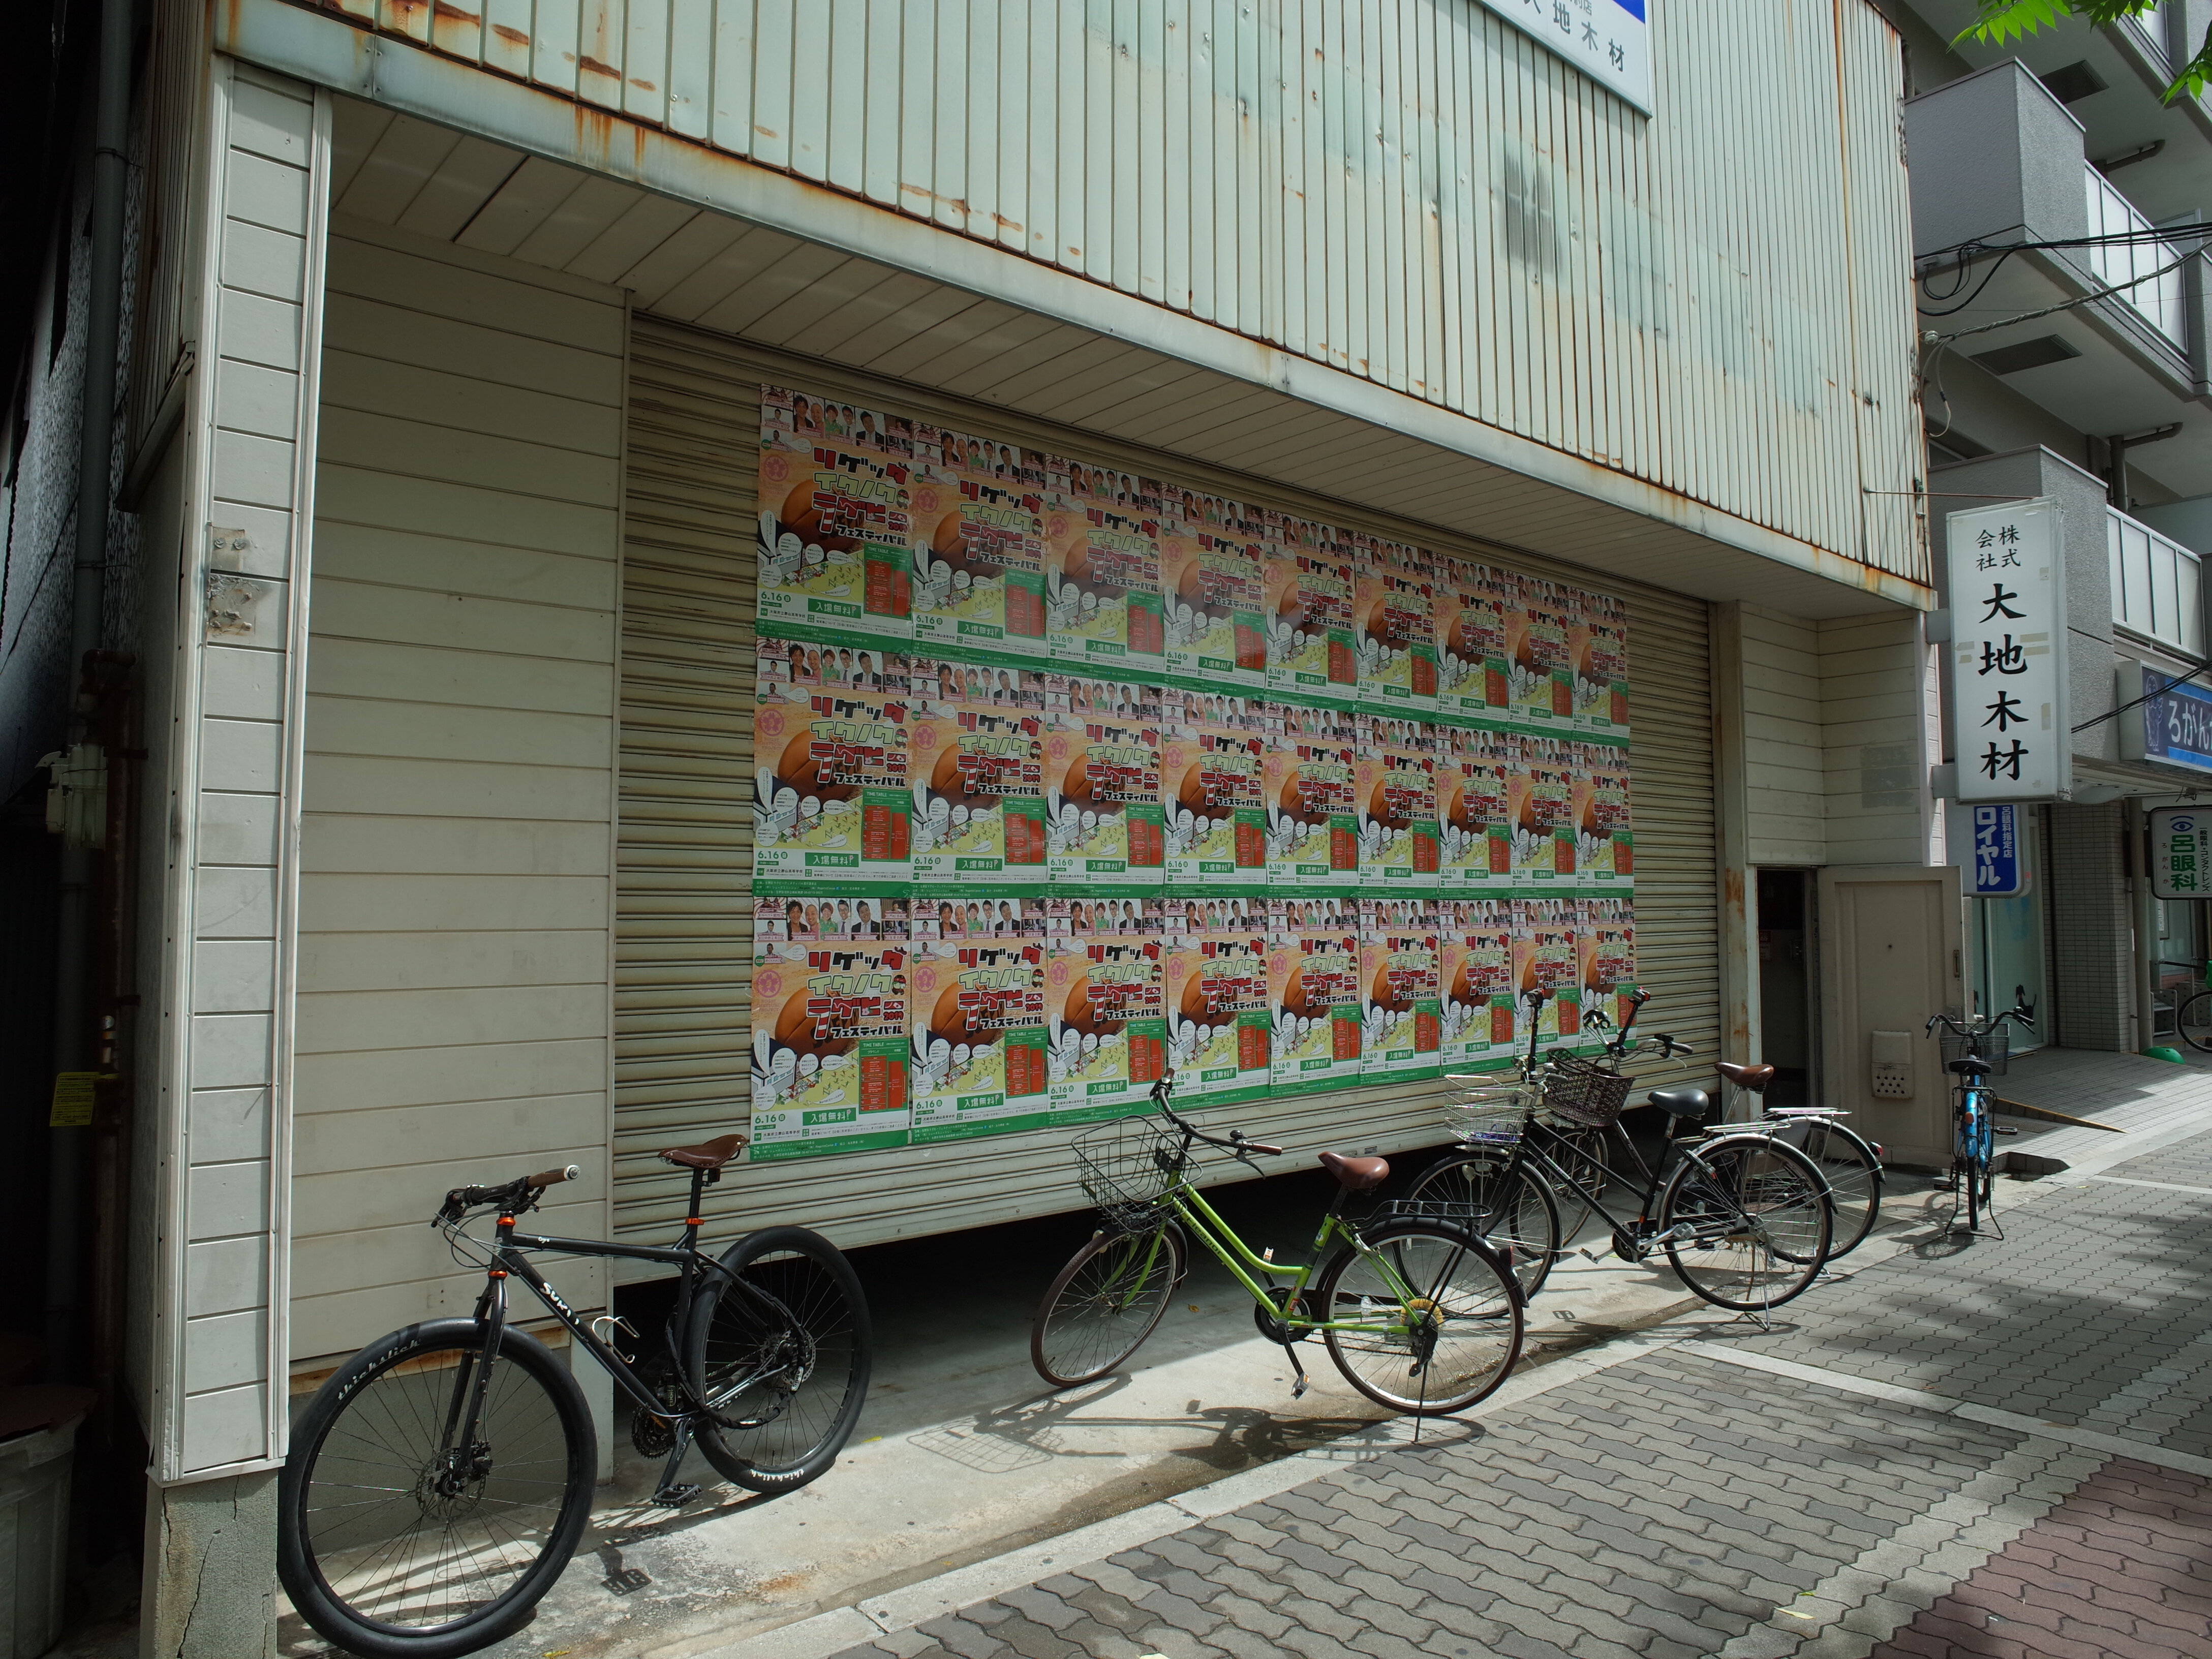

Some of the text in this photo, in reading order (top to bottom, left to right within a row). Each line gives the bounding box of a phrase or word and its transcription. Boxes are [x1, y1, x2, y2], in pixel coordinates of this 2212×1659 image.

[813, 493, 908, 532] ラグビー
[887, 521, 907, 533] 2019
[837, 525, 907, 546] フェスティバル
[960, 523, 1041, 559] ラグビー
[1024, 548, 1041, 559] 2019
[981, 552, 1041, 571] フェスティバル
[1087, 547, 1158, 581] ラグビー
[1144, 570, 1158, 580] 2019
[1105, 575, 1159, 592] フェスティバル
[1199, 570, 1261, 602] ラグビー
[761, 591, 782, 602] 6.16
[1248, 592, 1262, 601] 2019
[1215, 596, 1262, 612] フェスティバル
[917, 615, 935, 625] 6.16
[1311, 615, 1353, 629] フェスティバル
[1050, 634, 1066, 643] 6.16
[1396, 631, 1433, 644] フェスティバル
[1167, 651, 1181, 660] 6.16
[1978, 583, 2028, 781] 大地木材
[2168, 699, 2212, 750] ろがん
[810, 743, 906, 782] ラグビー
[885, 763, 906, 773] 2019
[958, 756, 1040, 791] ラグビー
[1023, 774, 1040, 782] 2019
[834, 774, 906, 787] フェスティバル
[1087, 765, 1158, 798] ラグビー
[1143, 782, 1158, 790] 2019
[979, 784, 1040, 795] フェスティバル
[1200, 773, 1263, 804] ラグビー
[1105, 791, 1159, 802] フェスティバル
[1216, 797, 1263, 807] フェスティバル
[1313, 804, 1355, 813] フェスティバル
[1398, 810, 1434, 819] フェスティバル
[2002, 806, 2013, 858] 呂眼科指定店
[1977, 807, 2001, 885] ロイヤル
[757, 850, 779, 859] 6.16
[915, 856, 933, 865] 6.16
[2199, 827, 2210, 891] 一般眼科・コンタクトレンズ
[2171, 835, 2198, 891] 呂眼科
[1145, 995, 1160, 1004] 2019
[1202, 976, 1266, 1011] ラグビー
[1252, 989, 1266, 997] 2019
[1315, 994, 1356, 1005] フェスティバル
[1401, 990, 1437, 1000] フェスティバル
[1025, 1002, 1042, 1011] 2019
[1088, 982, 1160, 1020] ラグビー
[1219, 999, 1266, 1012] フェスティバル
[883, 1010, 903, 1021] 2019
[959, 989, 1042, 1029] ラグビー
[1107, 1007, 1160, 1021] フェスティバル
[808, 996, 904, 1038] ラグビー
[980, 1015, 1042, 1029] フェスティバル
[832, 1024, 903, 1039] フェスティバル
[1051, 1085, 1067, 1094] 6.16
[916, 1099, 934, 1110] 6.16
[755, 1113, 776, 1124] 6.16
[1187, 1217, 1223, 1256] Eleanor
